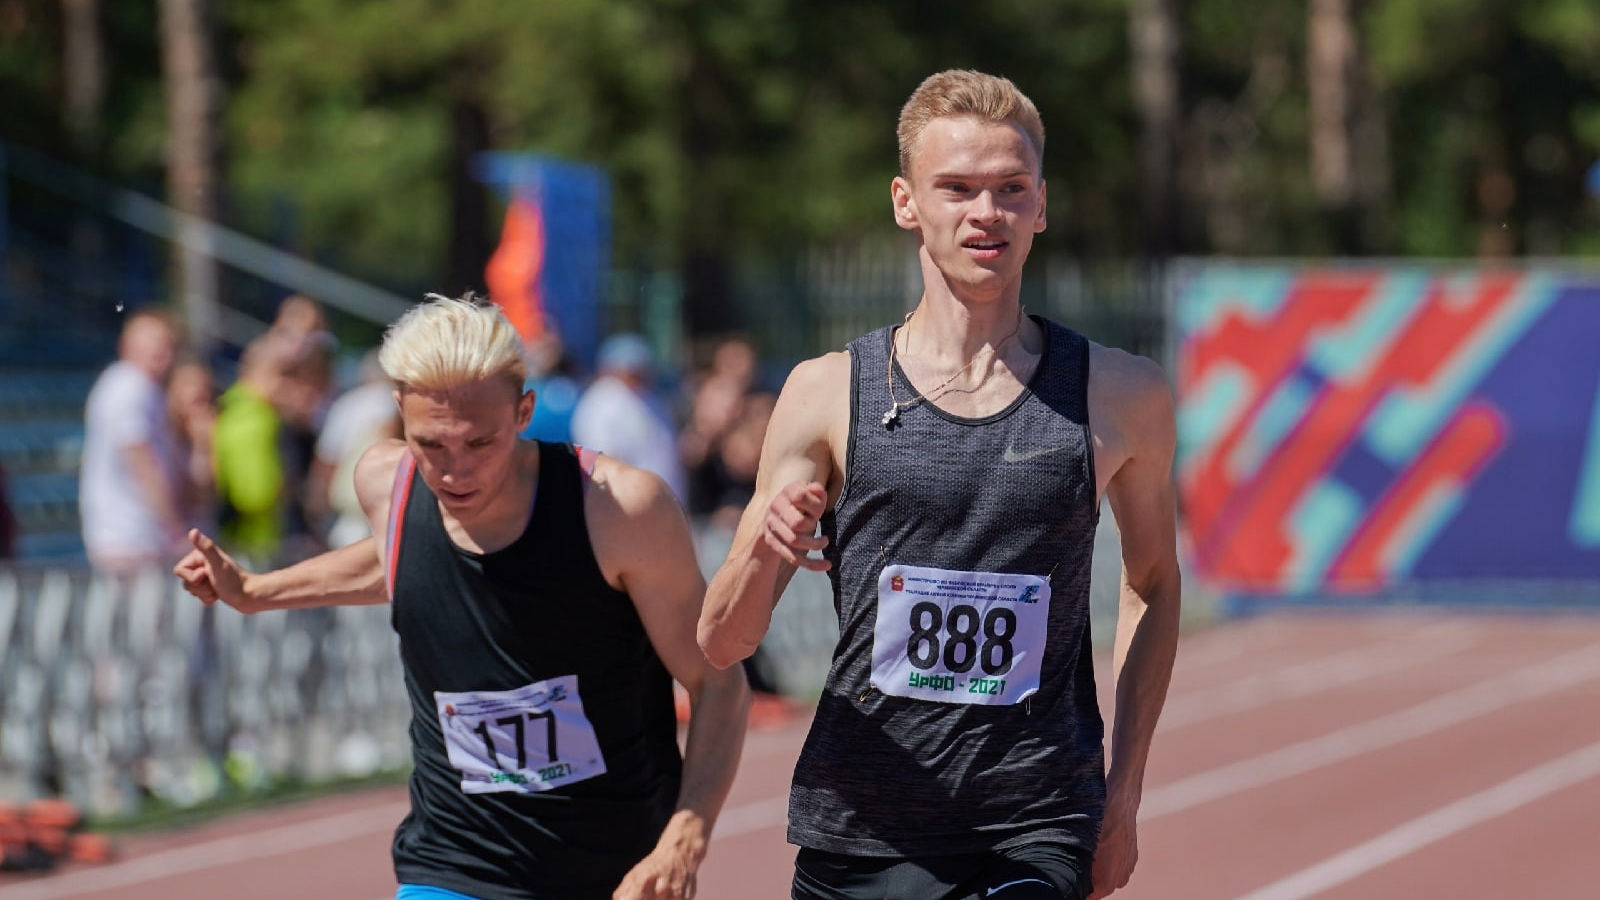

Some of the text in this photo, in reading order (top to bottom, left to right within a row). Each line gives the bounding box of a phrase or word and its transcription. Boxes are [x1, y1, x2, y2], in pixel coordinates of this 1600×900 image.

[907, 601, 1017, 676] 888
[968, 677, 1006, 696] 2021
[473, 708, 559, 770] 177
[537, 763, 572, 782] 2021
